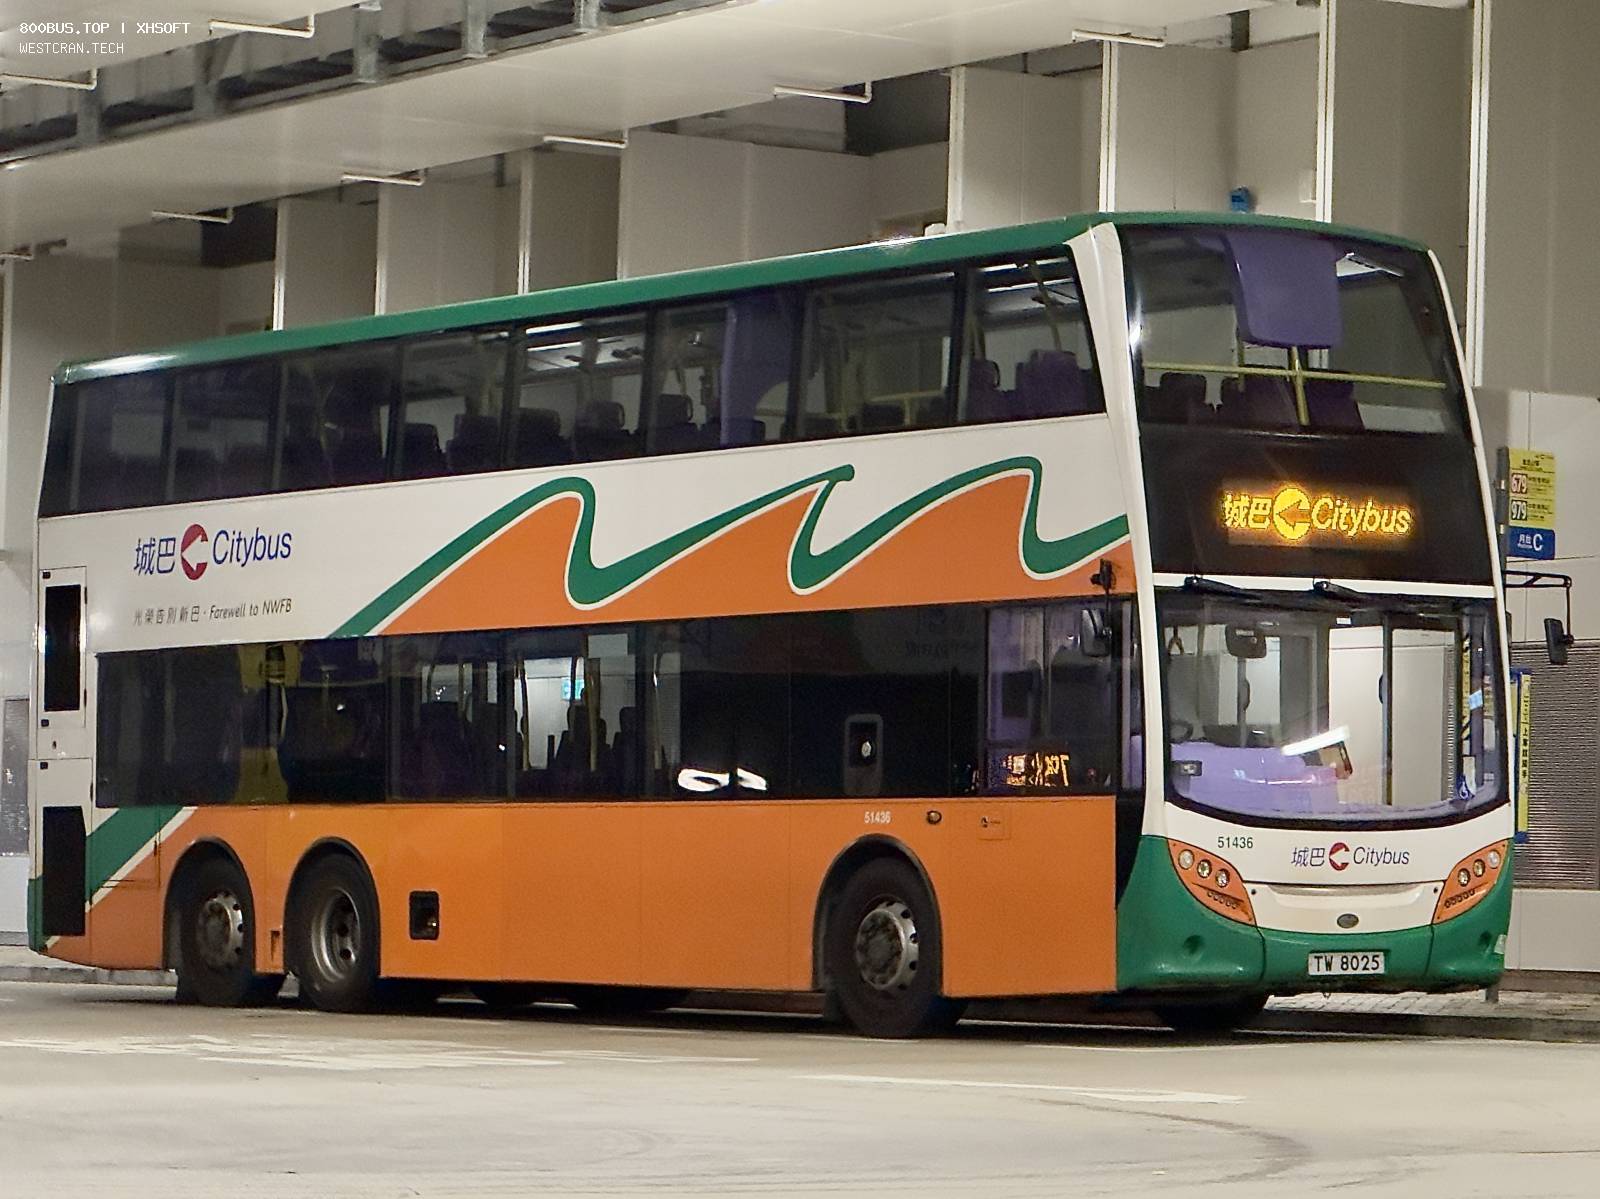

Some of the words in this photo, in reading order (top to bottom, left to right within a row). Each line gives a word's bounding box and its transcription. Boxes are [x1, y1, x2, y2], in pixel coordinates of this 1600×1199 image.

[1511, 474, 1527, 493] 679
[1223, 492, 1273, 530] 城巴
[1311, 495, 1412, 537] Citybus
[1511, 501, 1527, 520] 979
[133, 537, 176, 576] 城巴
[212, 527, 292, 567] Citybus
[1533, 533, 1543, 551] C
[209, 602, 246, 621] Farewell
[250, 602, 259, 616] to
[262, 598, 292, 616] NWFB
[864, 810, 891, 824] 51436
[1217, 836, 1254, 849] 51436
[1291, 846, 1326, 868] 城巴
[1353, 846, 1410, 867] Citybus
[1313, 955, 1334, 972] TW
[1340, 954, 1380, 971] 8025
